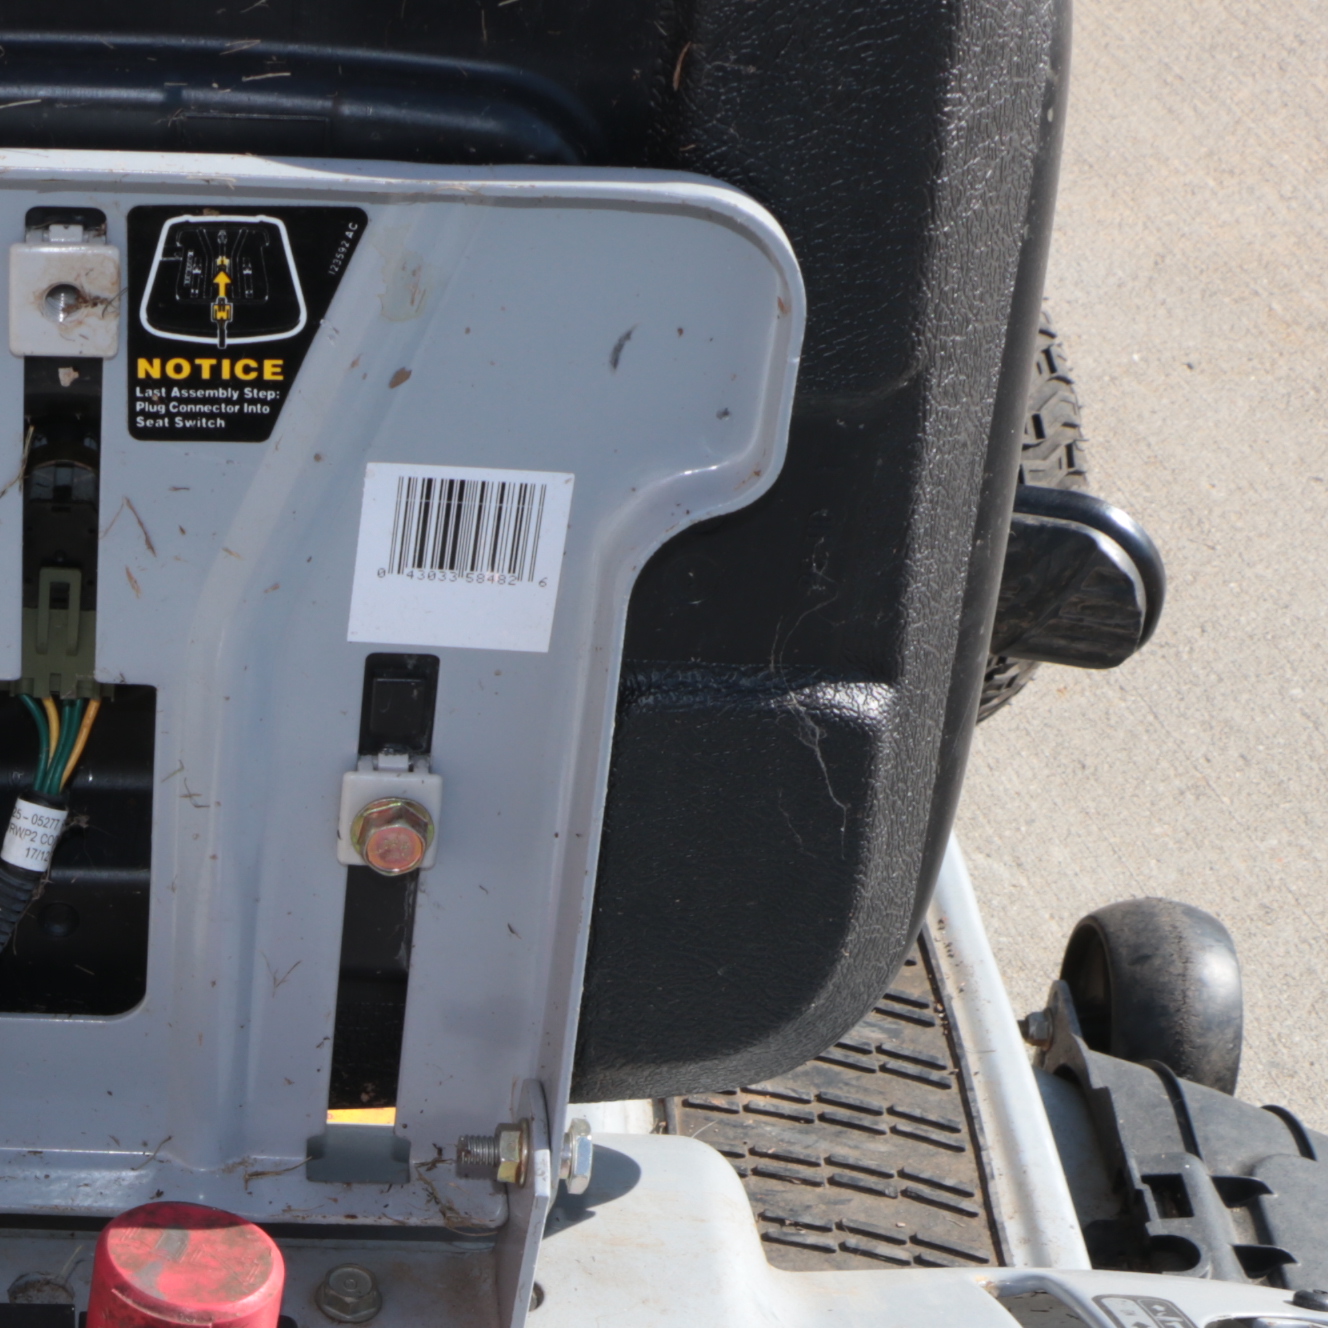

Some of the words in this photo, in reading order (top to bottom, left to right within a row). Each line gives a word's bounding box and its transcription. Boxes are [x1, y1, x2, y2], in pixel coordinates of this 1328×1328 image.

[328, 240, 350, 274] 123592
[345, 222, 358, 239] AC
[137, 358, 284, 380] NOTICE
[136, 386, 166, 397] Last
[171, 387, 239, 400] Assembly
[244, 388, 280, 400] Step:
[136, 402, 166, 414] Plug
[169, 402, 240, 413] Connector
[244, 403, 270, 413] Into
[136, 416, 169, 427] Seat
[175, 417, 225, 428] Switch
[377, 570, 386, 579] 0
[406, 570, 458, 582] 43033
[466, 572, 517, 586] 58482
[538, 577, 548, 588] 6
